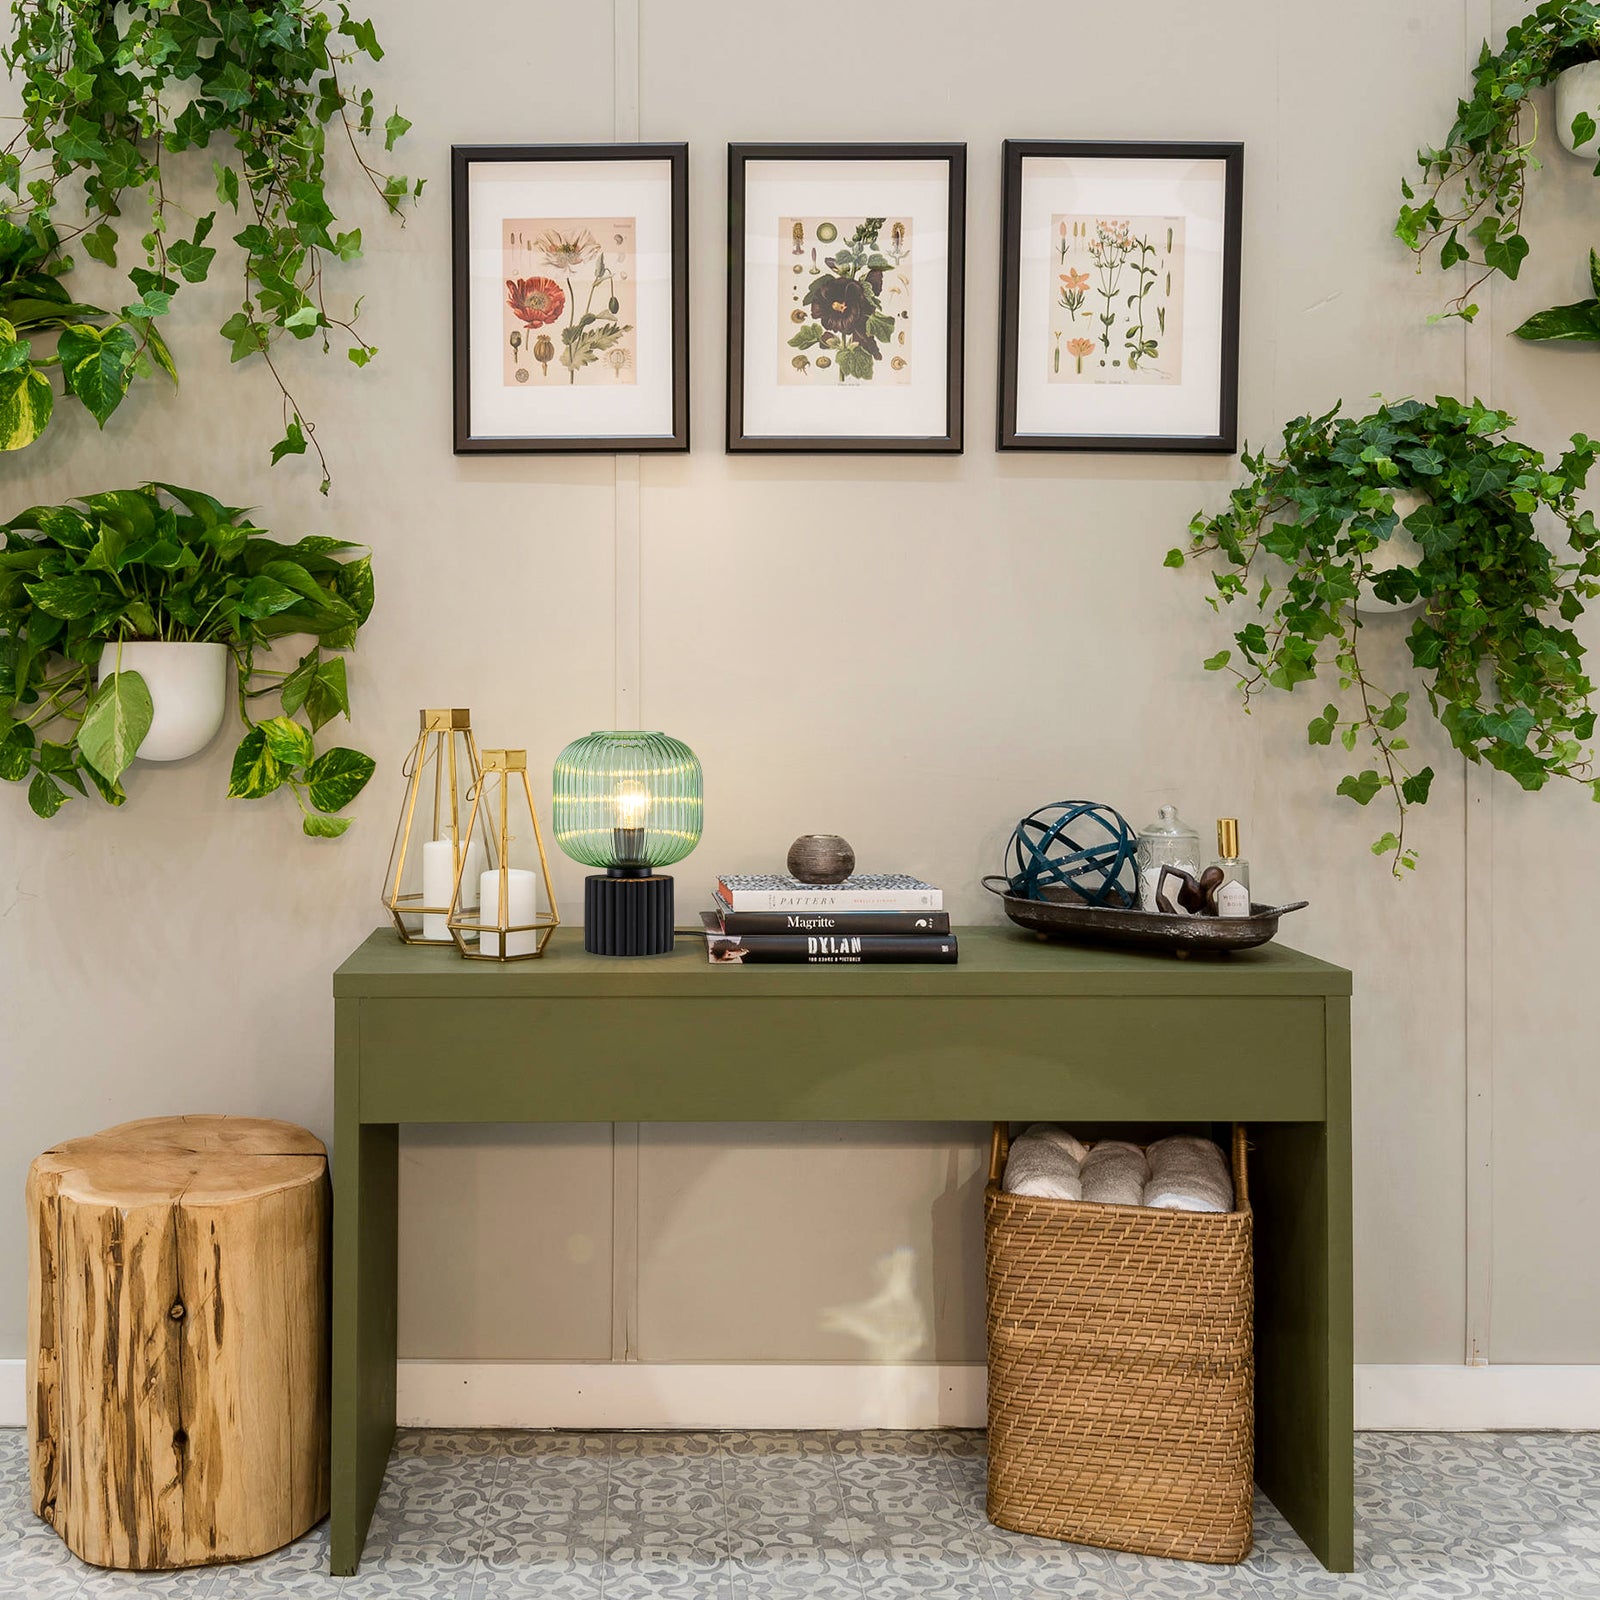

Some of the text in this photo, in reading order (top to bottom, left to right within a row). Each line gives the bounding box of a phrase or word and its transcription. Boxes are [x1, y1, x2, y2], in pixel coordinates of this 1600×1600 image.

[780, 897, 836, 905] PATTERN
[788, 915, 835, 929] Magritte
[808, 937, 862, 954] DYLAN
